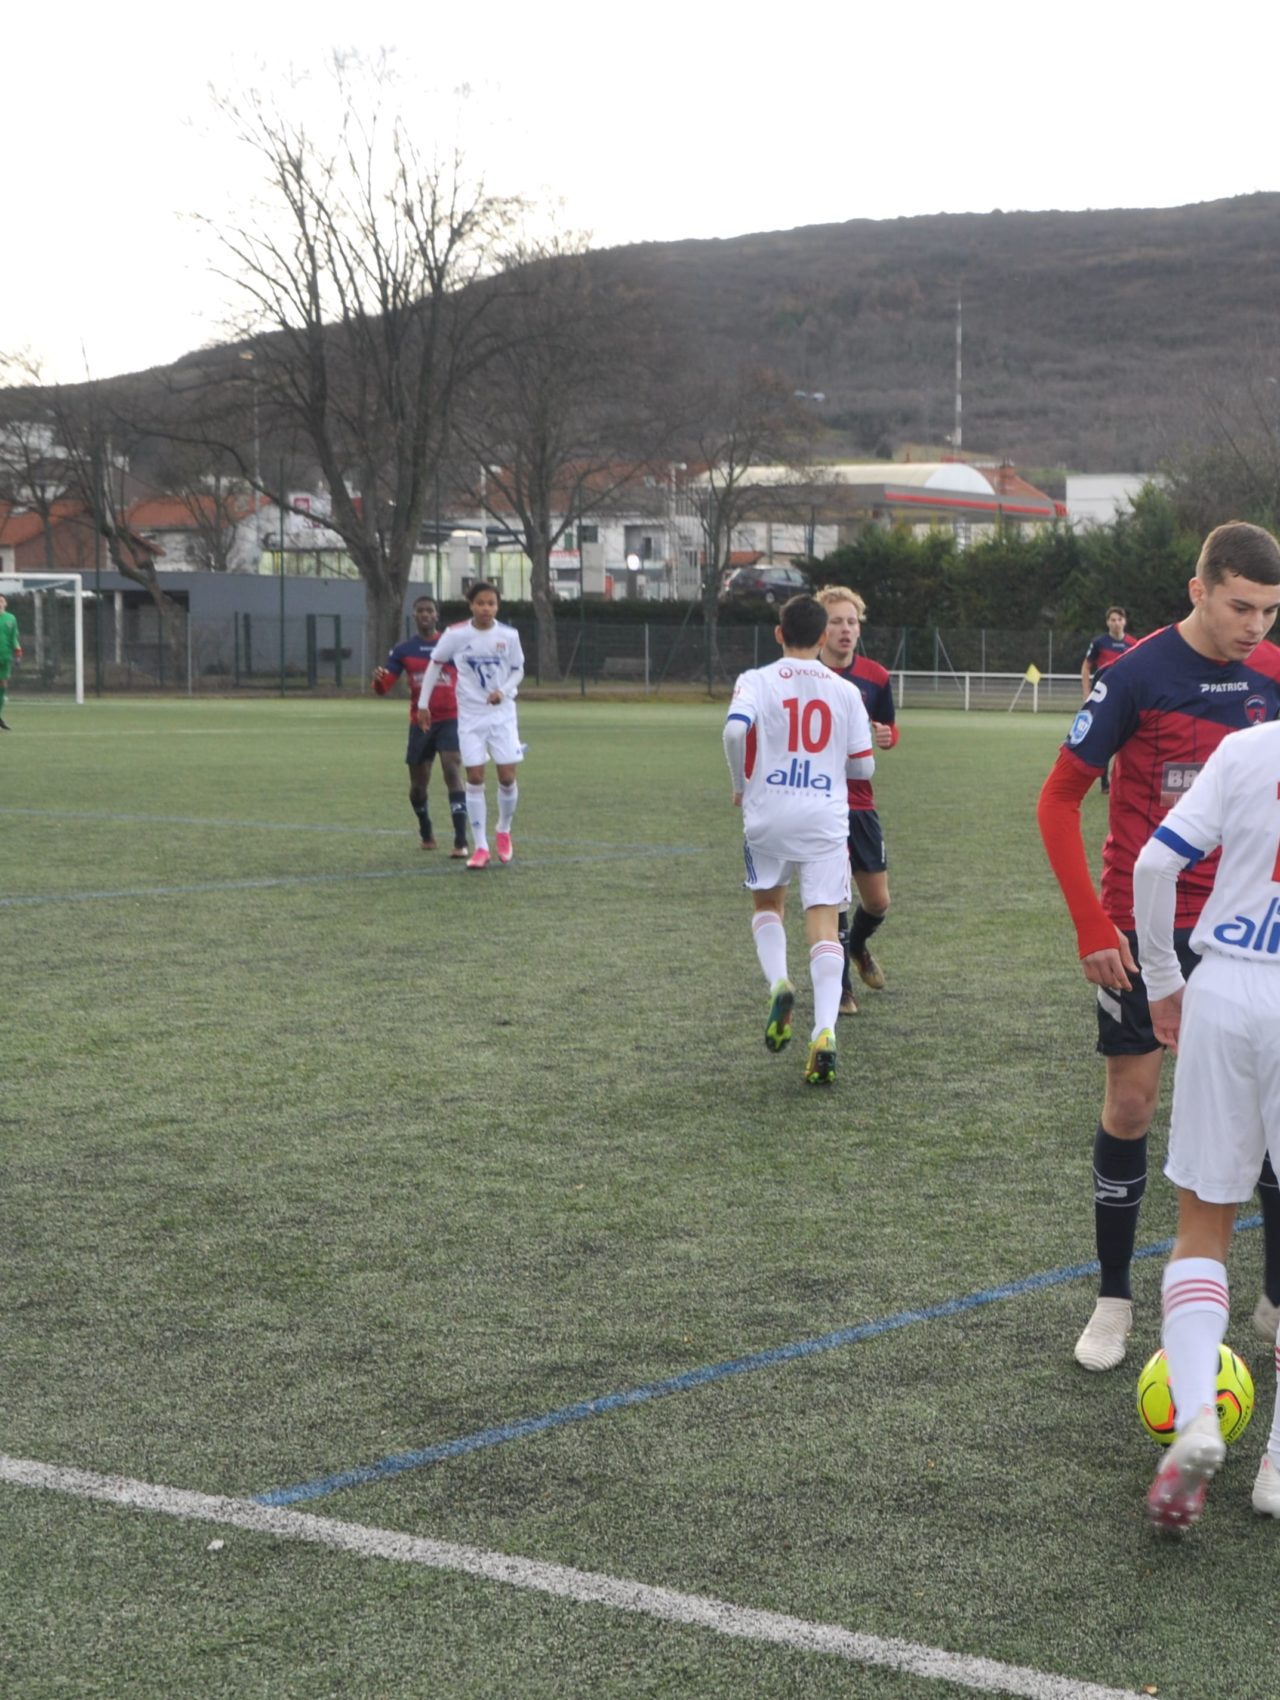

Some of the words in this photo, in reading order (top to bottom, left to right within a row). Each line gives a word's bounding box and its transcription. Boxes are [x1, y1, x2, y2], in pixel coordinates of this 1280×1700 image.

[794, 668, 832, 680] VEOLIA
[1210, 681, 1249, 692] PATRICK
[782, 697, 833, 754] 10
[766, 757, 832, 791] alila
